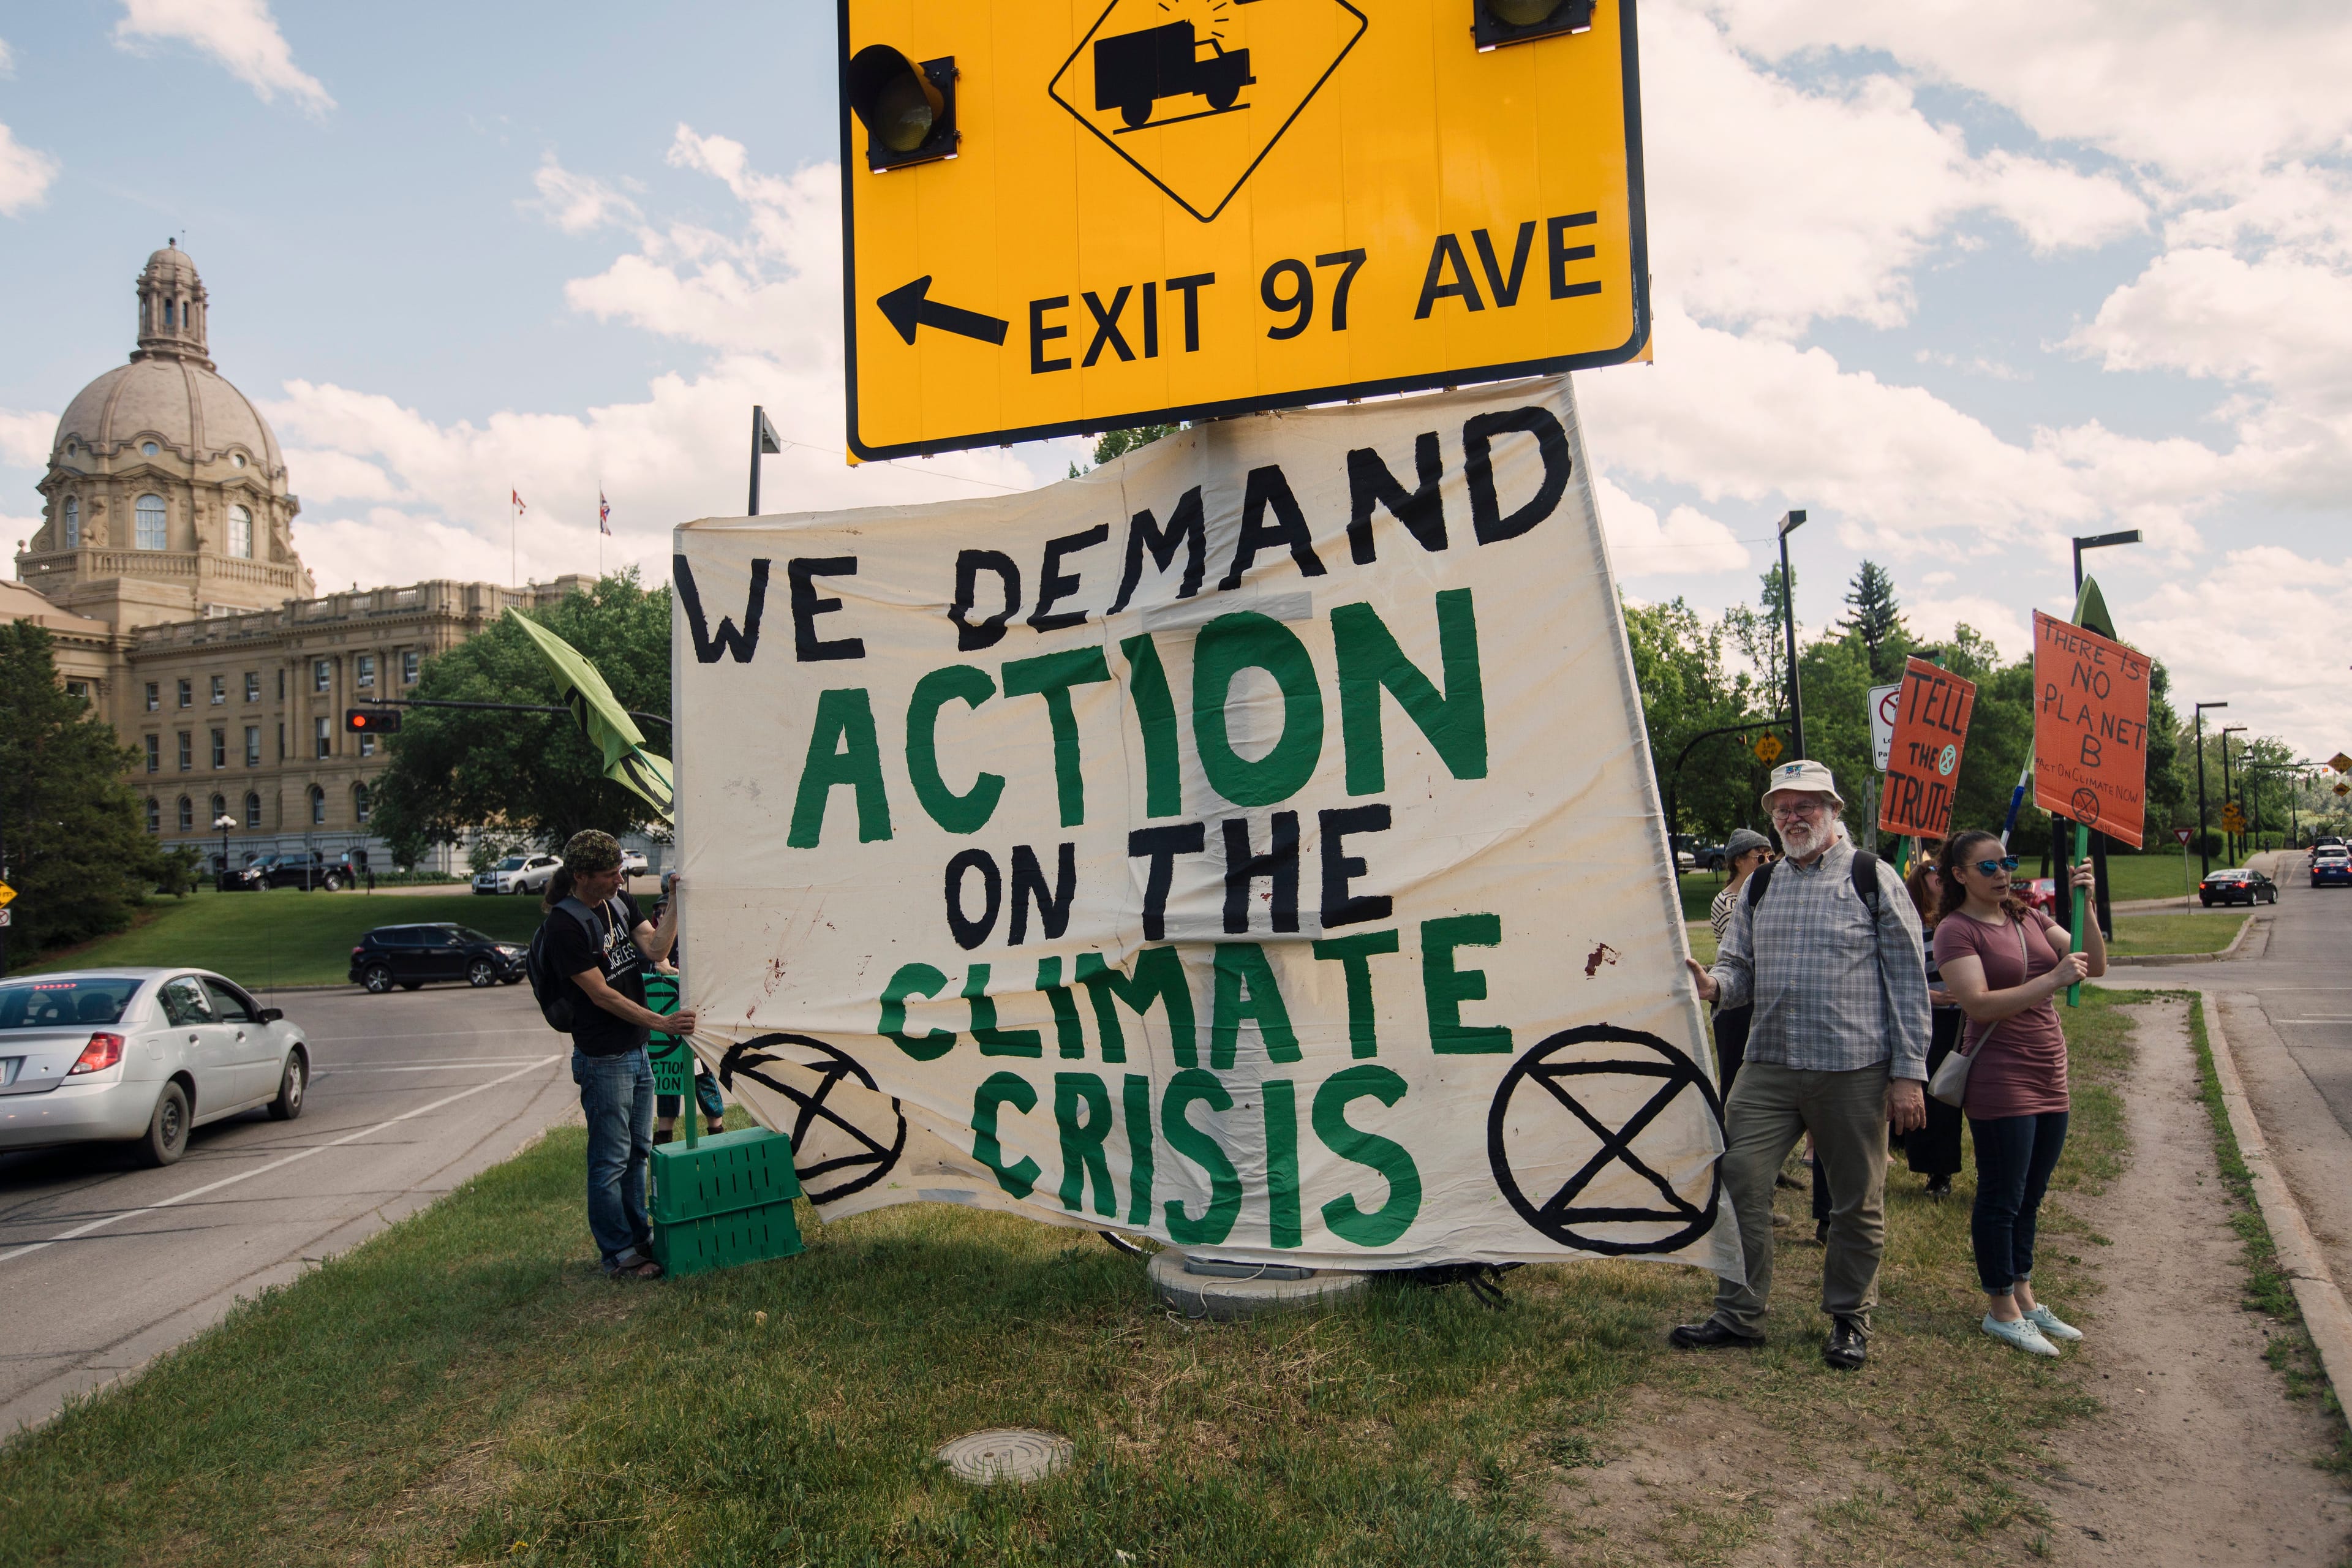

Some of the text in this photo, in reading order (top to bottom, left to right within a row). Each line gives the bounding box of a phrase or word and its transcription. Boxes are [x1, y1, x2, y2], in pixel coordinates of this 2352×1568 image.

[1029, 210, 1602, 374] EXIT 97 AVE
[673, 405, 1572, 663] WE DEMAND
[2044, 618, 2141, 680] THERE IS
[2070, 662, 2111, 700] NO
[788, 587, 1488, 850] ACTION
[1907, 671, 1965, 735] TELL
[2044, 683, 2146, 750] PLANET
[1909, 742, 1937, 771] THE
[2080, 734, 2101, 768] B
[1888, 769, 1954, 834] TRUTH
[945, 804, 1392, 949] ON THE
[878, 912, 1513, 1068] CLIMATE
[650, 1061, 684, 1074] CTIO
[655, 1077, 680, 1090] ION
[972, 1063, 1422, 1249] CRISIS
